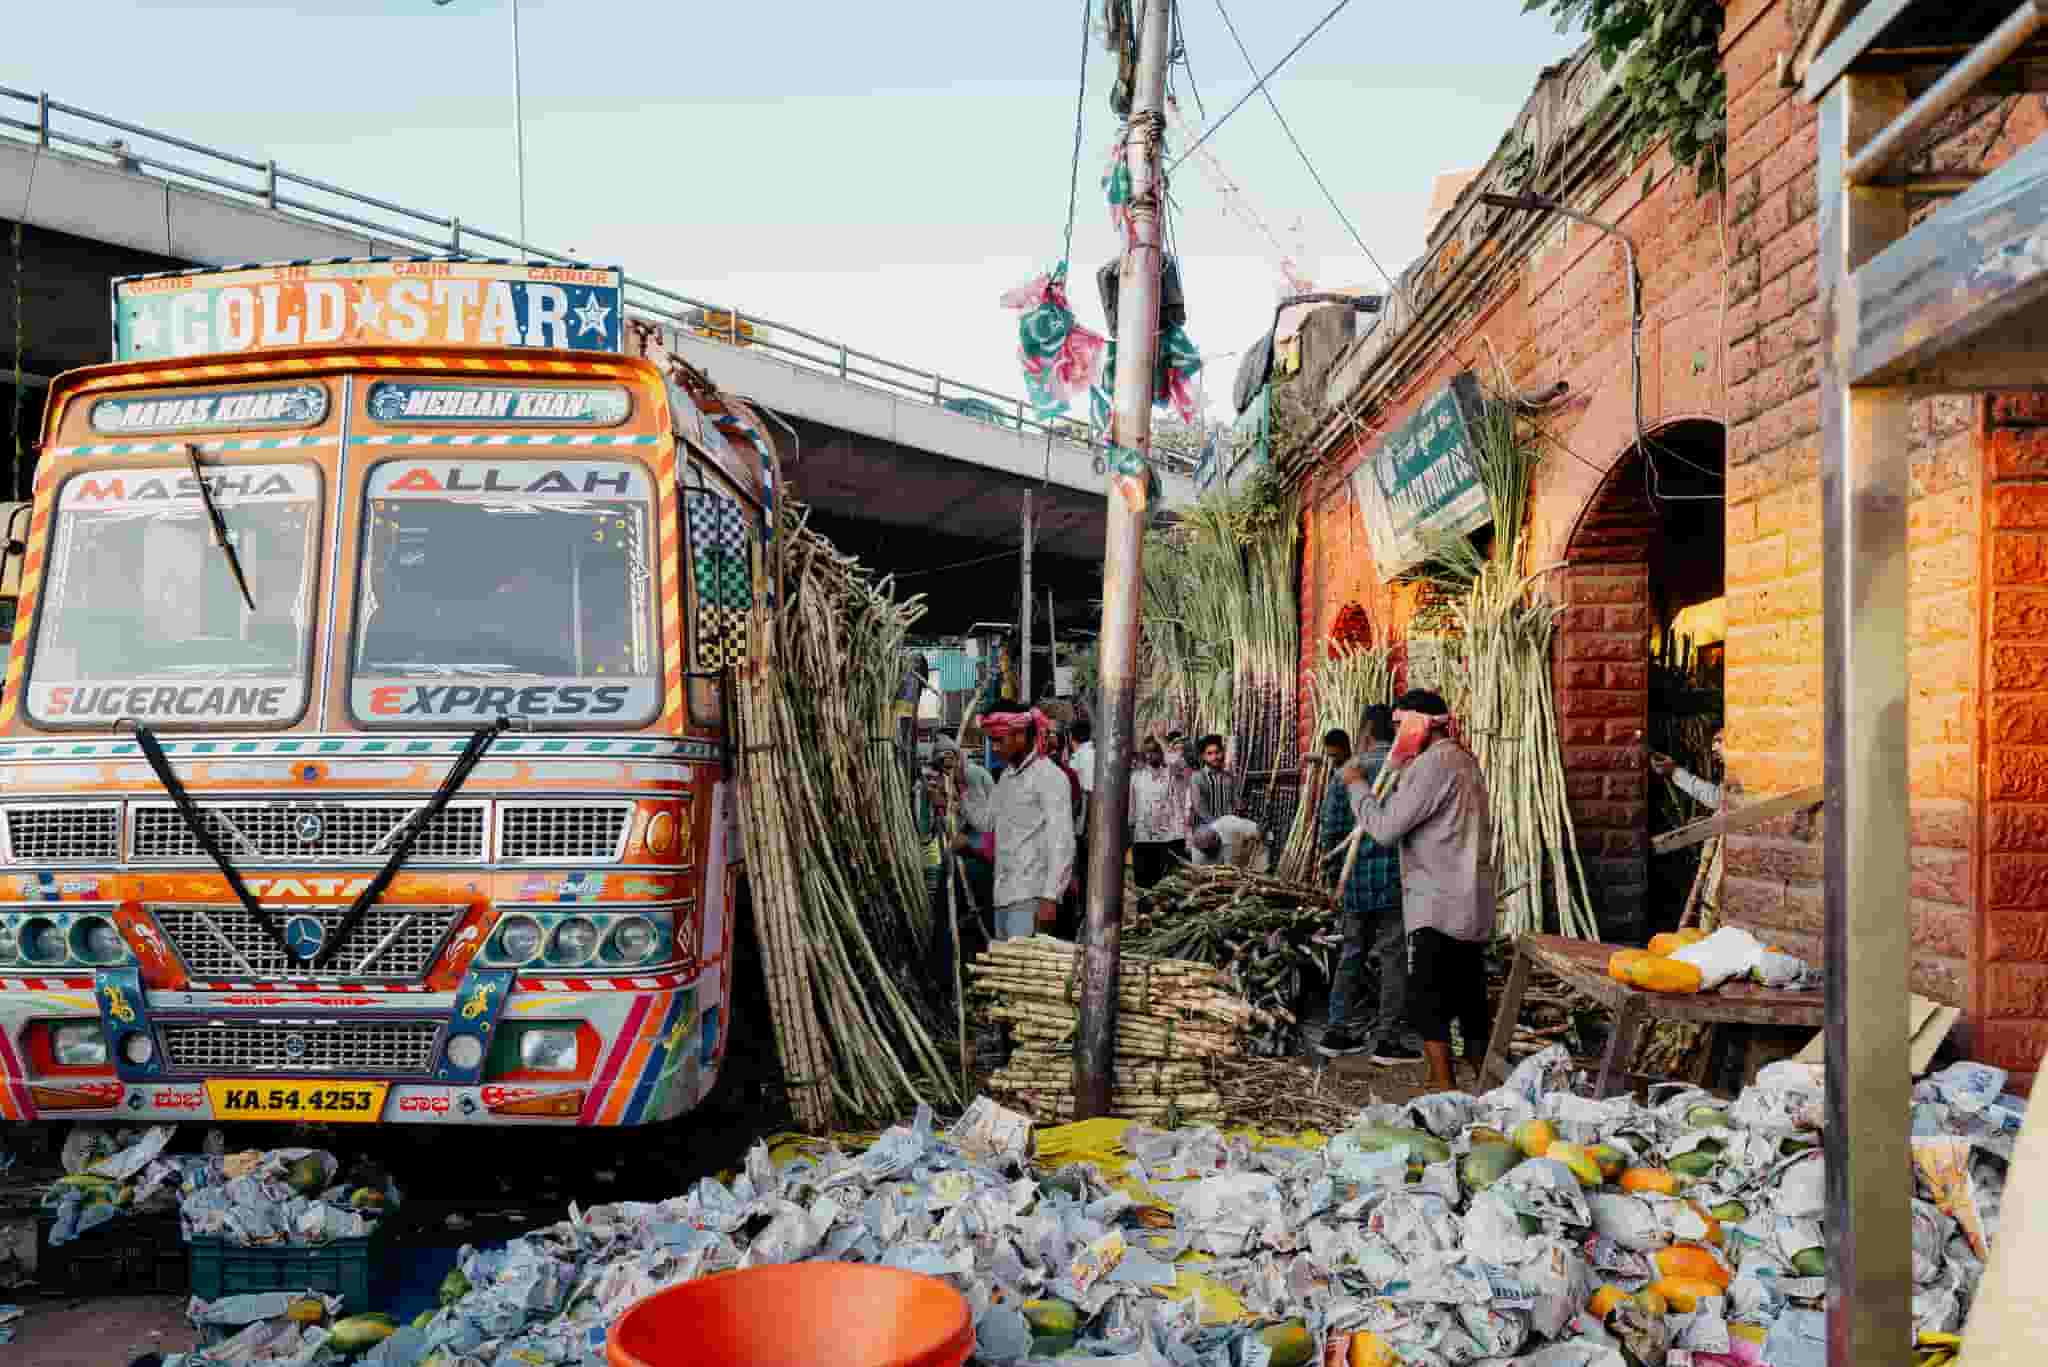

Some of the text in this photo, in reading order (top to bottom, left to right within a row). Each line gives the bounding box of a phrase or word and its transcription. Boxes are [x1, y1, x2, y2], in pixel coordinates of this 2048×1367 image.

[527, 268, 609, 285] CARRIER
[172, 279, 570, 352] GOLD STAR
[512, 391, 588, 417] KHAN
[76, 473, 296, 501] MASHA
[386, 467, 631, 493] ALLAH
[47, 686, 288, 715] SUGERCANE
[368, 685, 631, 715] EXPRESS
[222, 1089, 371, 1110] KA.54.4253
